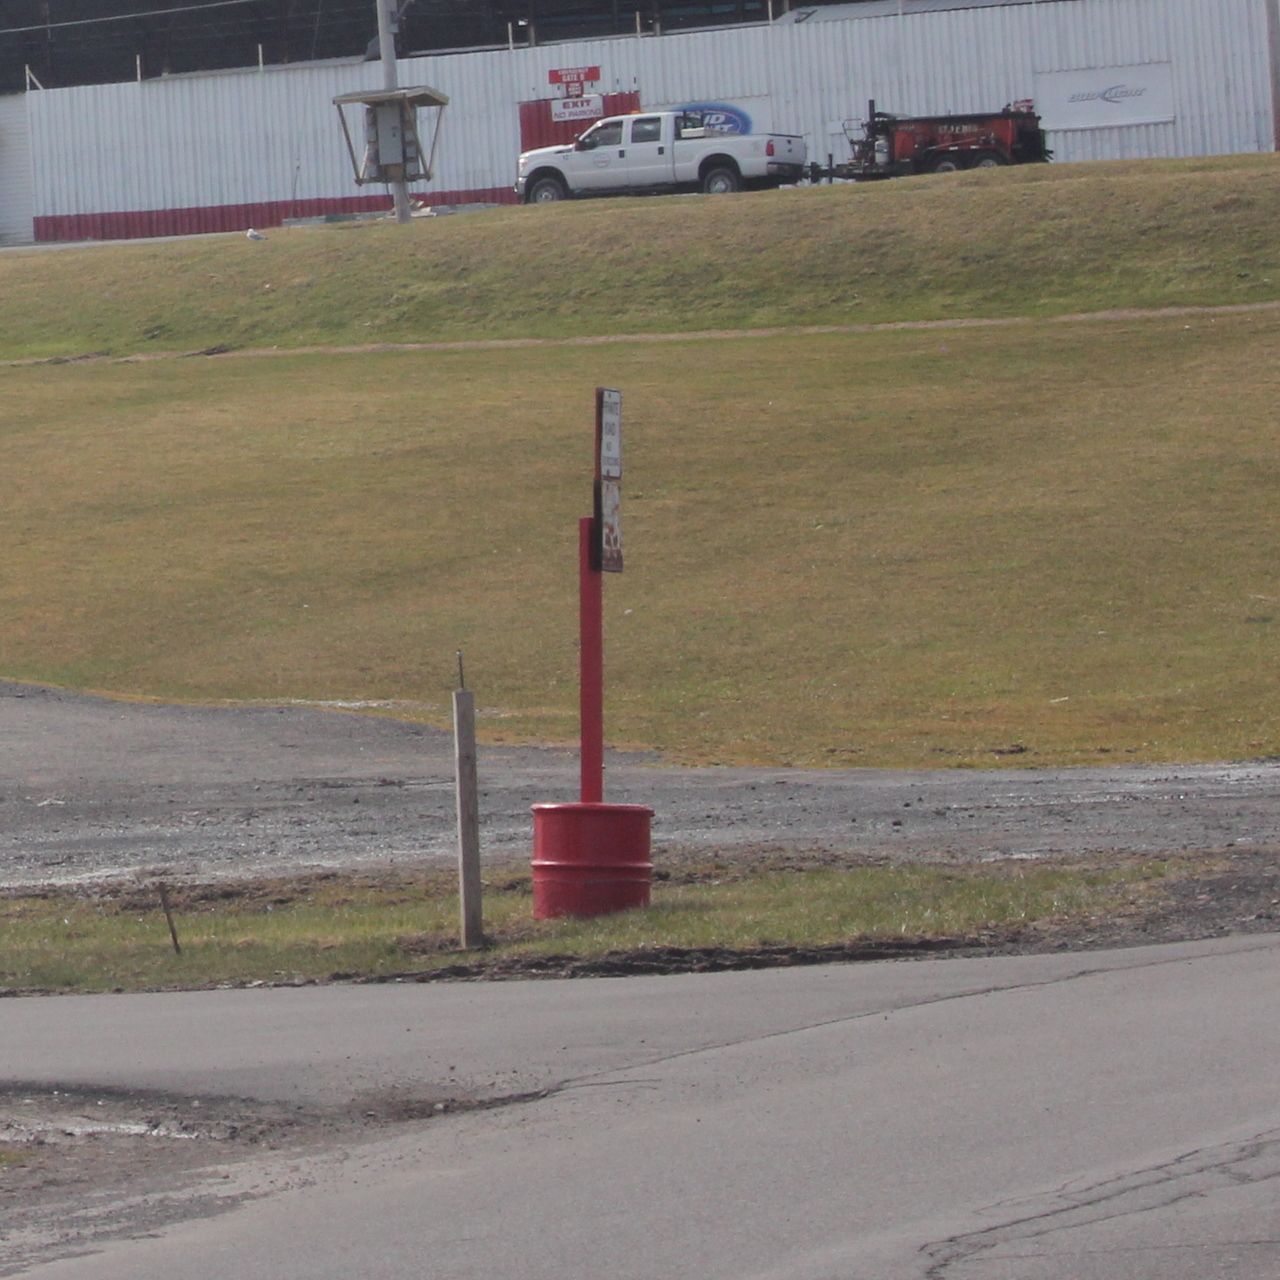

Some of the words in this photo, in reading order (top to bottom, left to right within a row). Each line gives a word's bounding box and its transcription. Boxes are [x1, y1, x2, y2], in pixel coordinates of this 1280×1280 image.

[563, 99, 591, 109] EXIT
[553, 111, 566, 119] NO
[568, 108, 601, 118] PARKING
